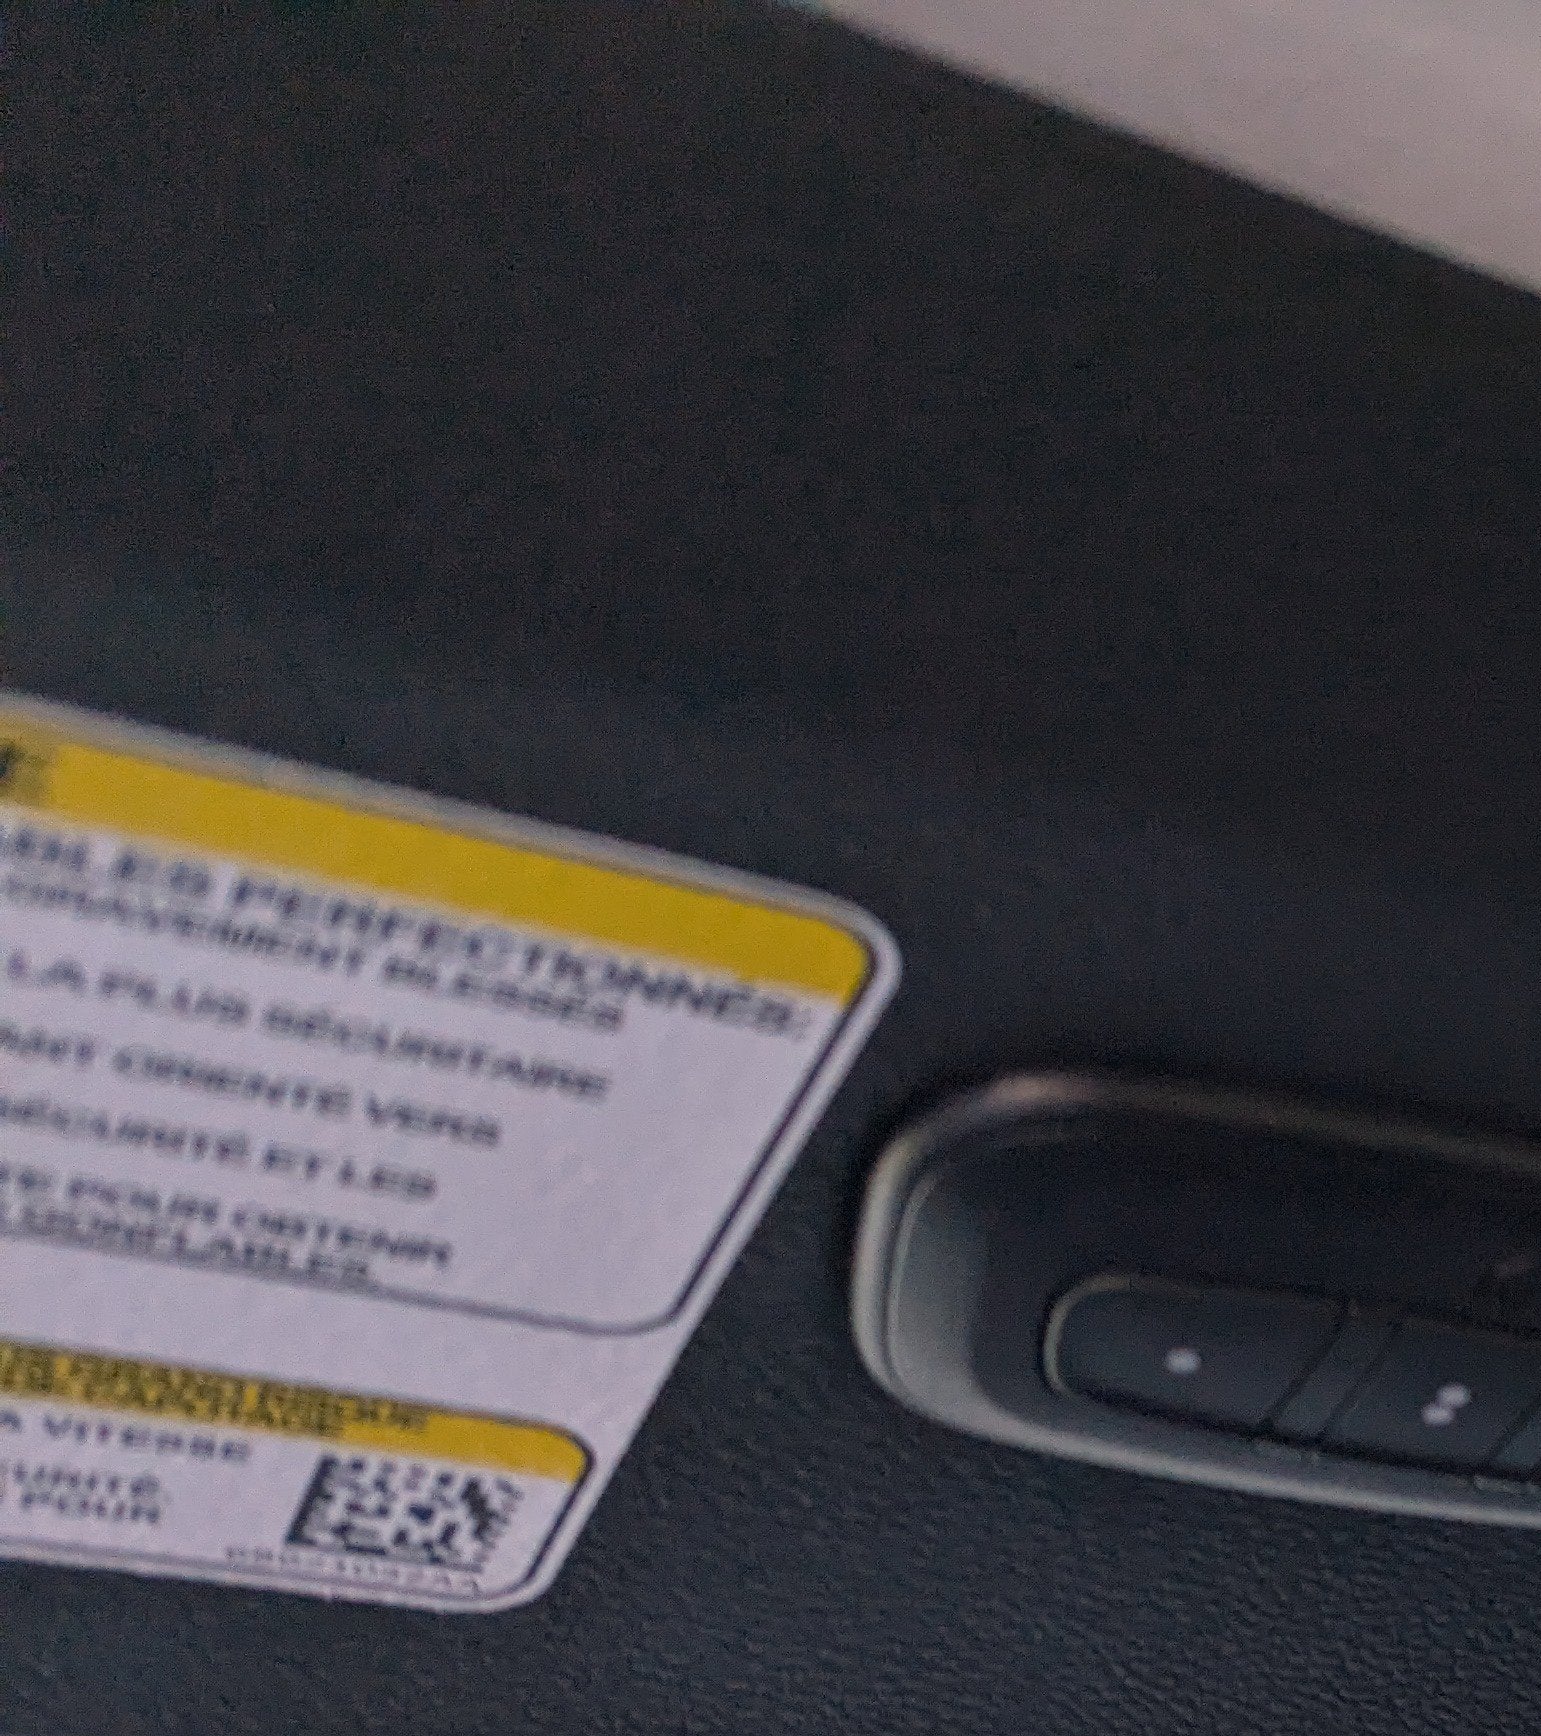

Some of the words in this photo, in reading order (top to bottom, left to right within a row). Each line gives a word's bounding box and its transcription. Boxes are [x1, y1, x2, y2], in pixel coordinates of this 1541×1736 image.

[0, 828, 210, 897] BLES
[4, 950, 86, 998] LA
[97, 968, 250, 1030] PLUS
[362, 1088, 503, 1149] VERS
[64, 1177, 221, 1228] POUR
[260, 1144, 322, 1183] ET
[336, 1157, 438, 1203] LES
[42, 1412, 252, 1463] VITESSE
